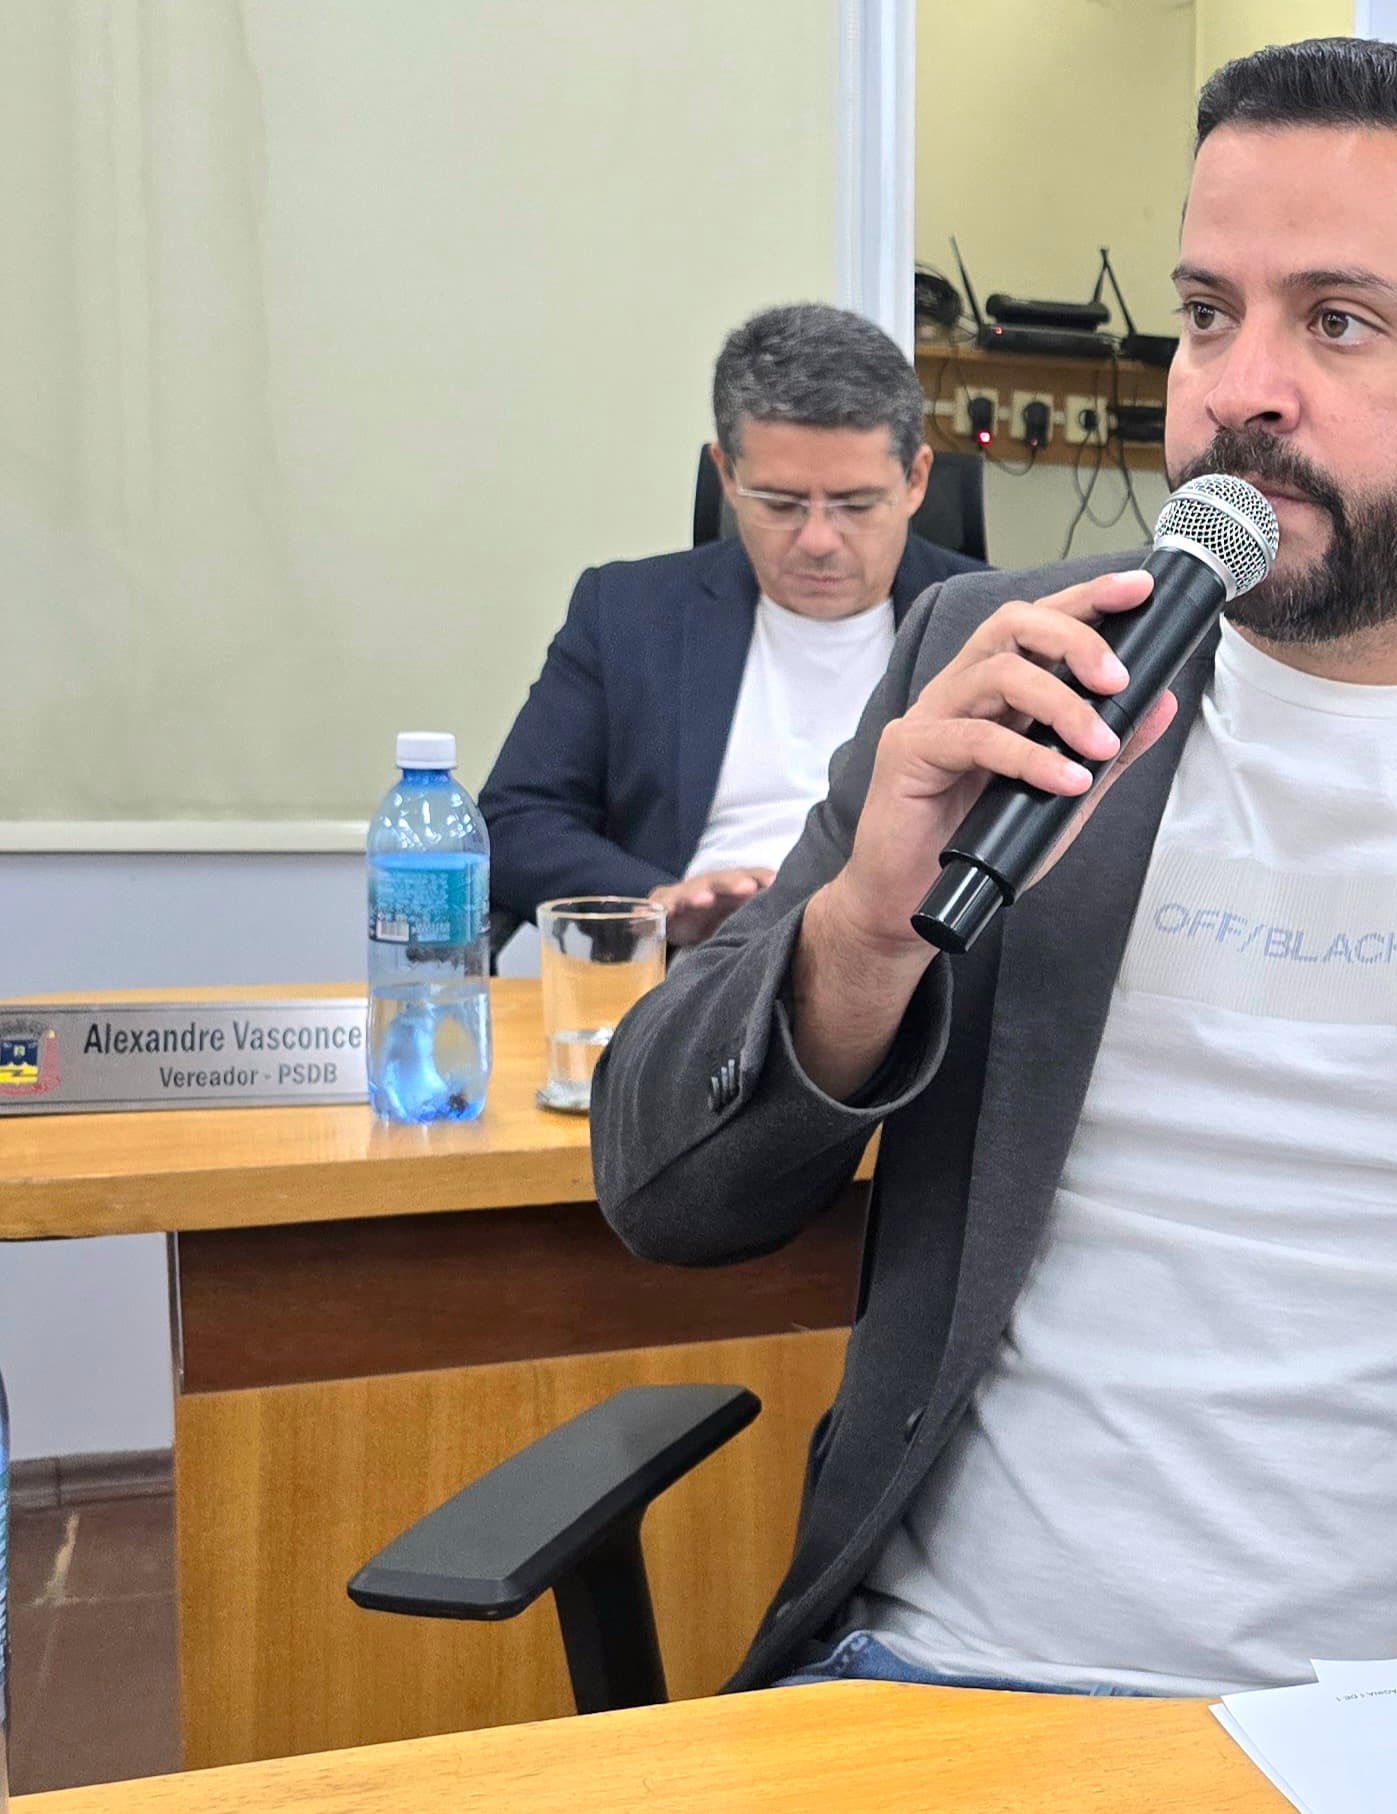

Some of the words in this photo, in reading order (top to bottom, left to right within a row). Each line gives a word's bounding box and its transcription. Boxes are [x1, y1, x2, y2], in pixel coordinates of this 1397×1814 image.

[83, 1021, 225, 1055] Alexandre
[232, 1020, 363, 1051] Vasconce
[159, 1066, 259, 1089] Vereador
[277, 1062, 339, 1086] PSDB
